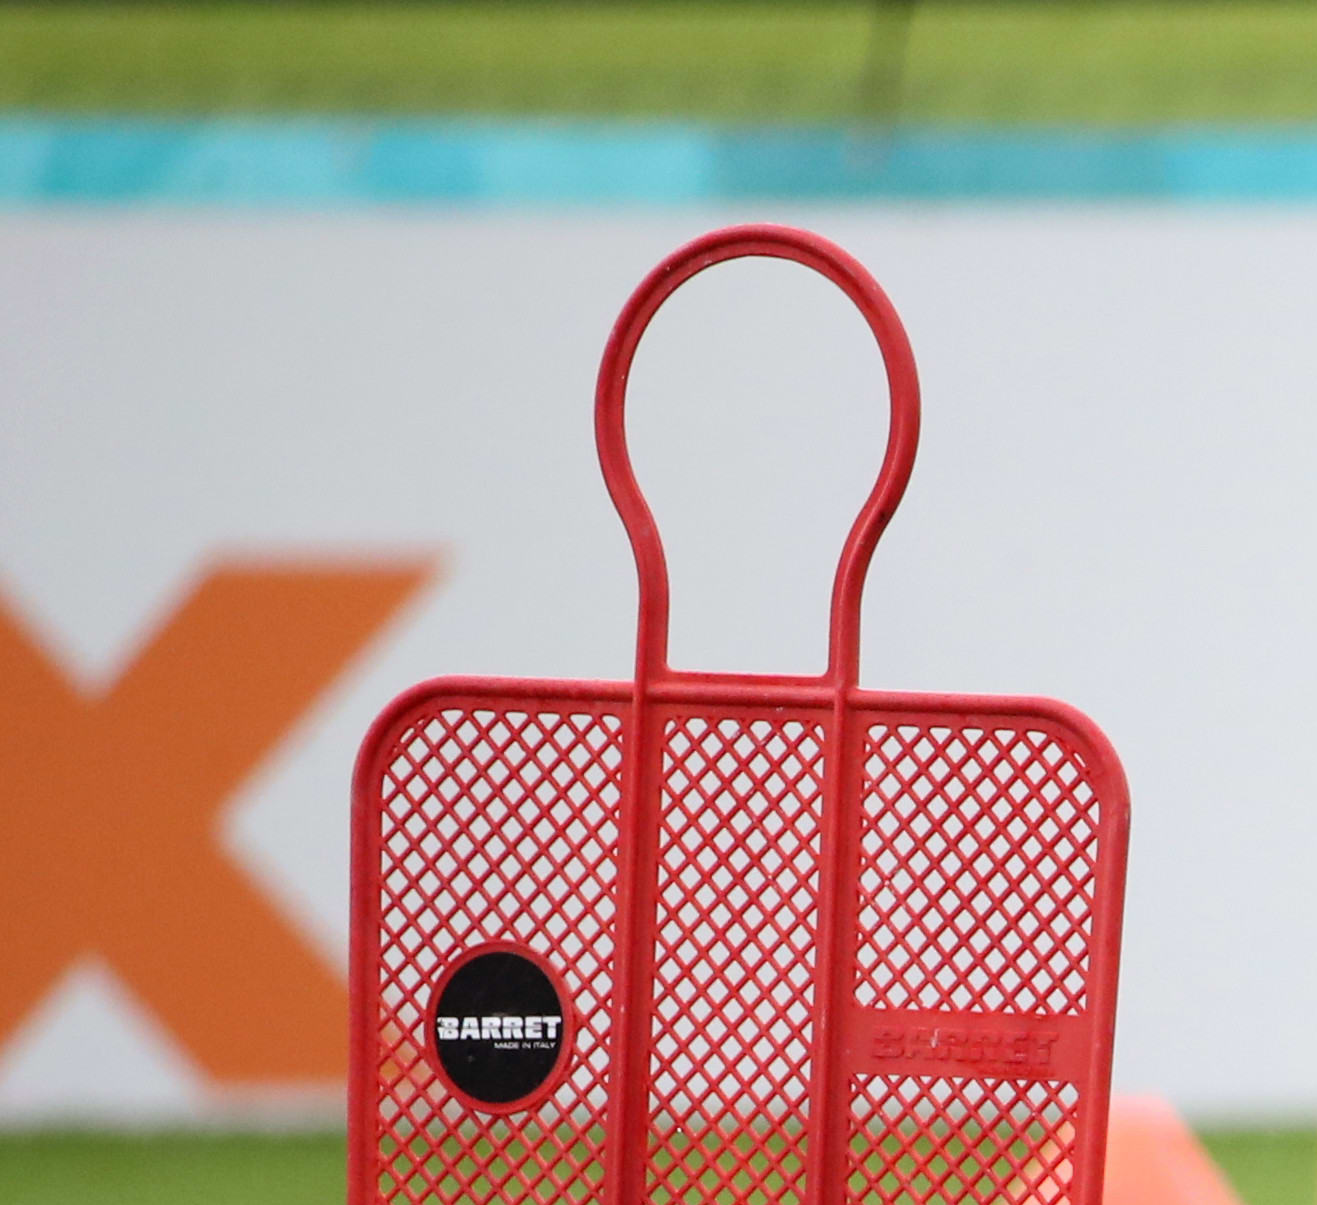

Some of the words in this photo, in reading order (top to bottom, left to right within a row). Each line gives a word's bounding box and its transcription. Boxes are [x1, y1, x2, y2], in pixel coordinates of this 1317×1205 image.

[437, 1016, 561, 1040] BARRET
[494, 1041, 519, 1049] MADE
[522, 1041, 531, 1049] IN
[533, 1041, 556, 1049] ITALY
